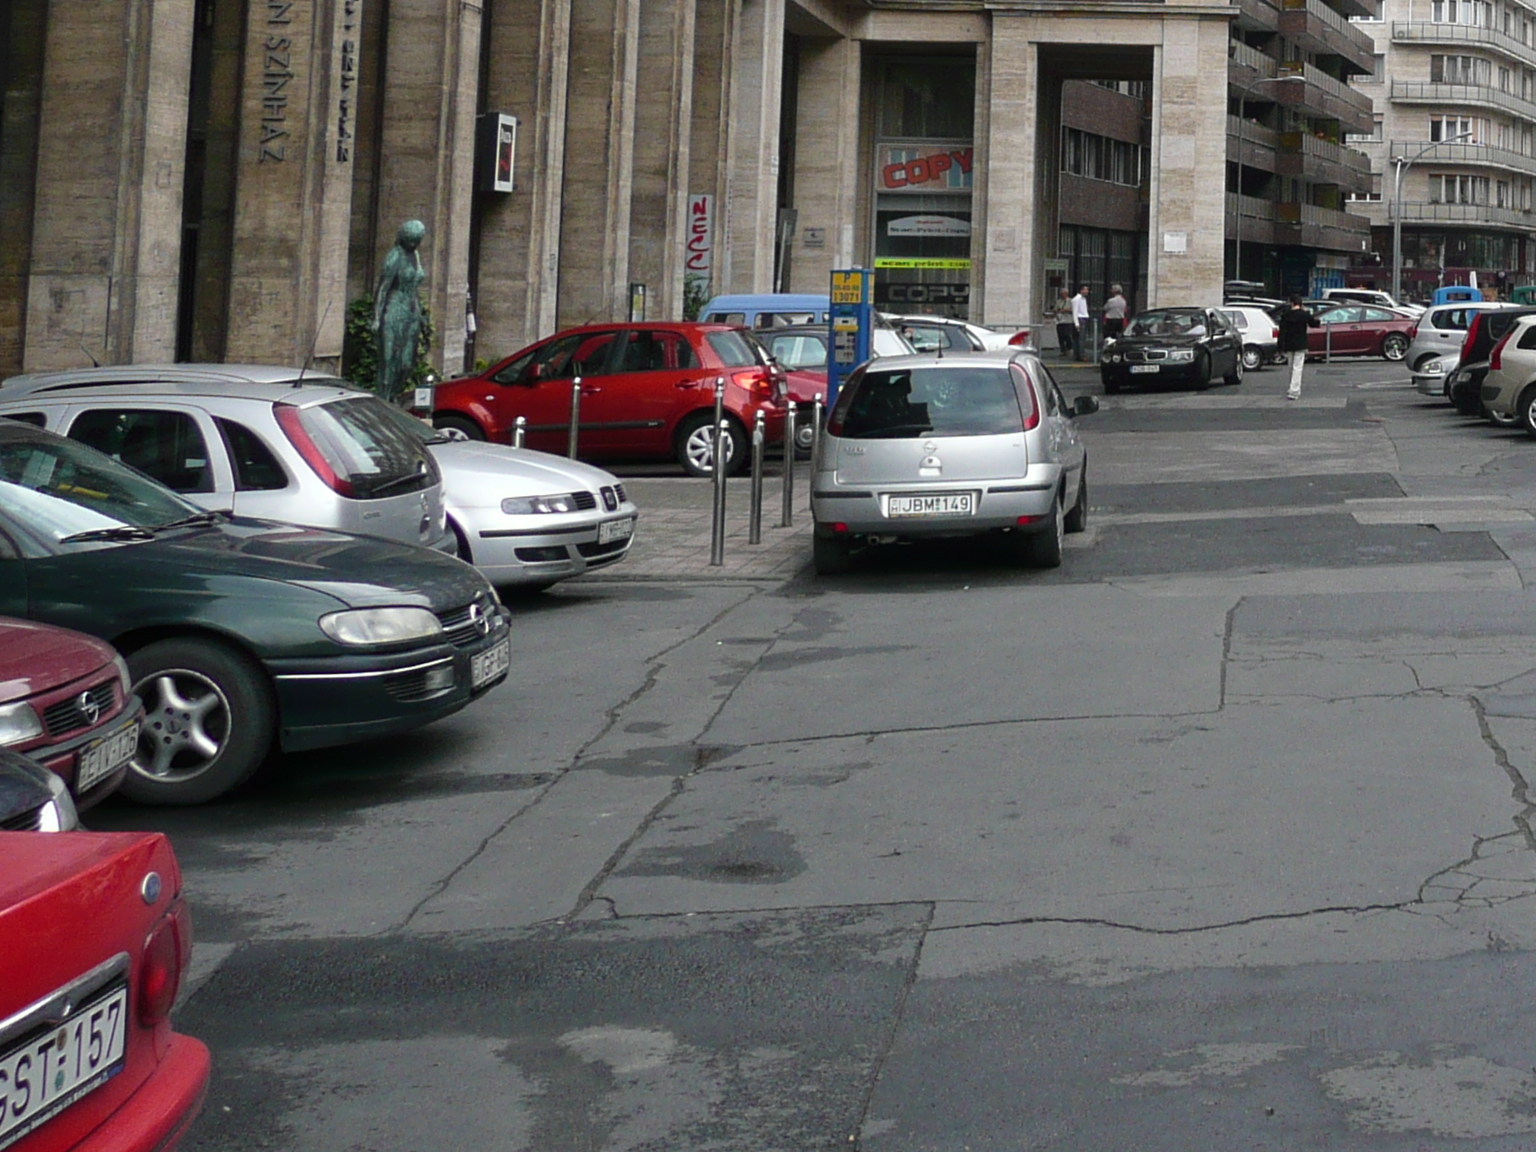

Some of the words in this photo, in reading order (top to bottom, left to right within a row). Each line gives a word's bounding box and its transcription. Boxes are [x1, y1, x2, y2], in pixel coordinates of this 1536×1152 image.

[259, 36, 295, 163] SZÍNHÁZ
[883, 148, 973, 188] COPY
[888, 285, 970, 302] COPY
